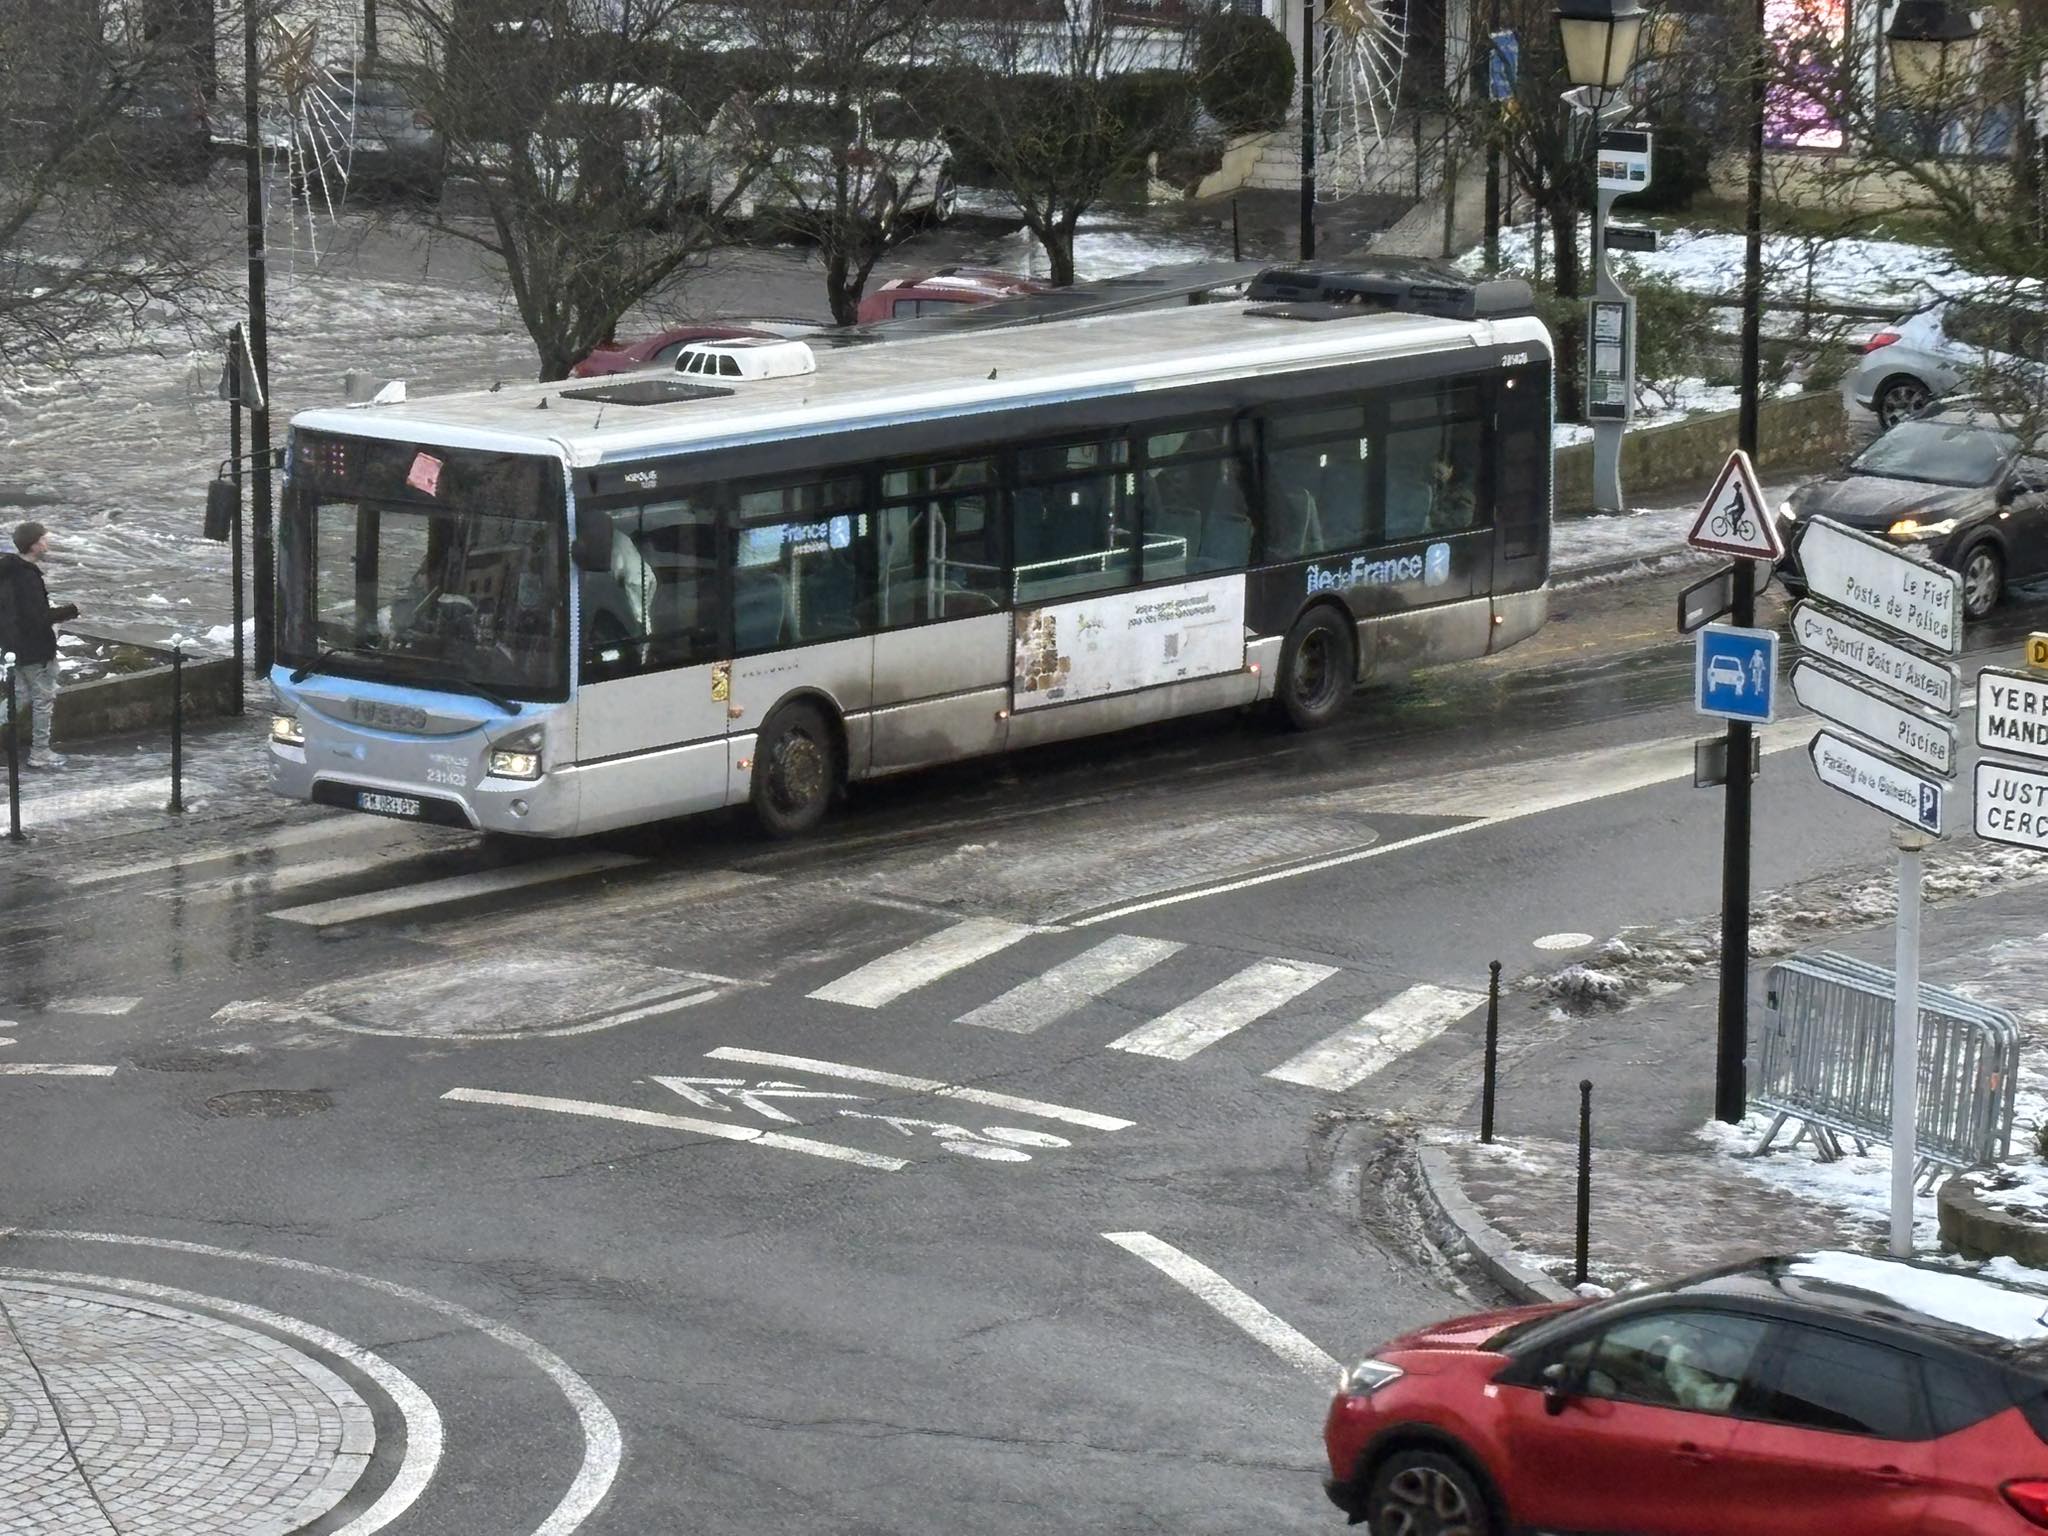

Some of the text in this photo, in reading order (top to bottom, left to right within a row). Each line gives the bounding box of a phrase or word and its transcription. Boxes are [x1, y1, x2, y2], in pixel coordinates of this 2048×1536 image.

[1846, 576, 1949, 640] Poste de Police
[1903, 571, 1950, 610] Le Fief
[1898, 720, 1945, 760] Piscine
